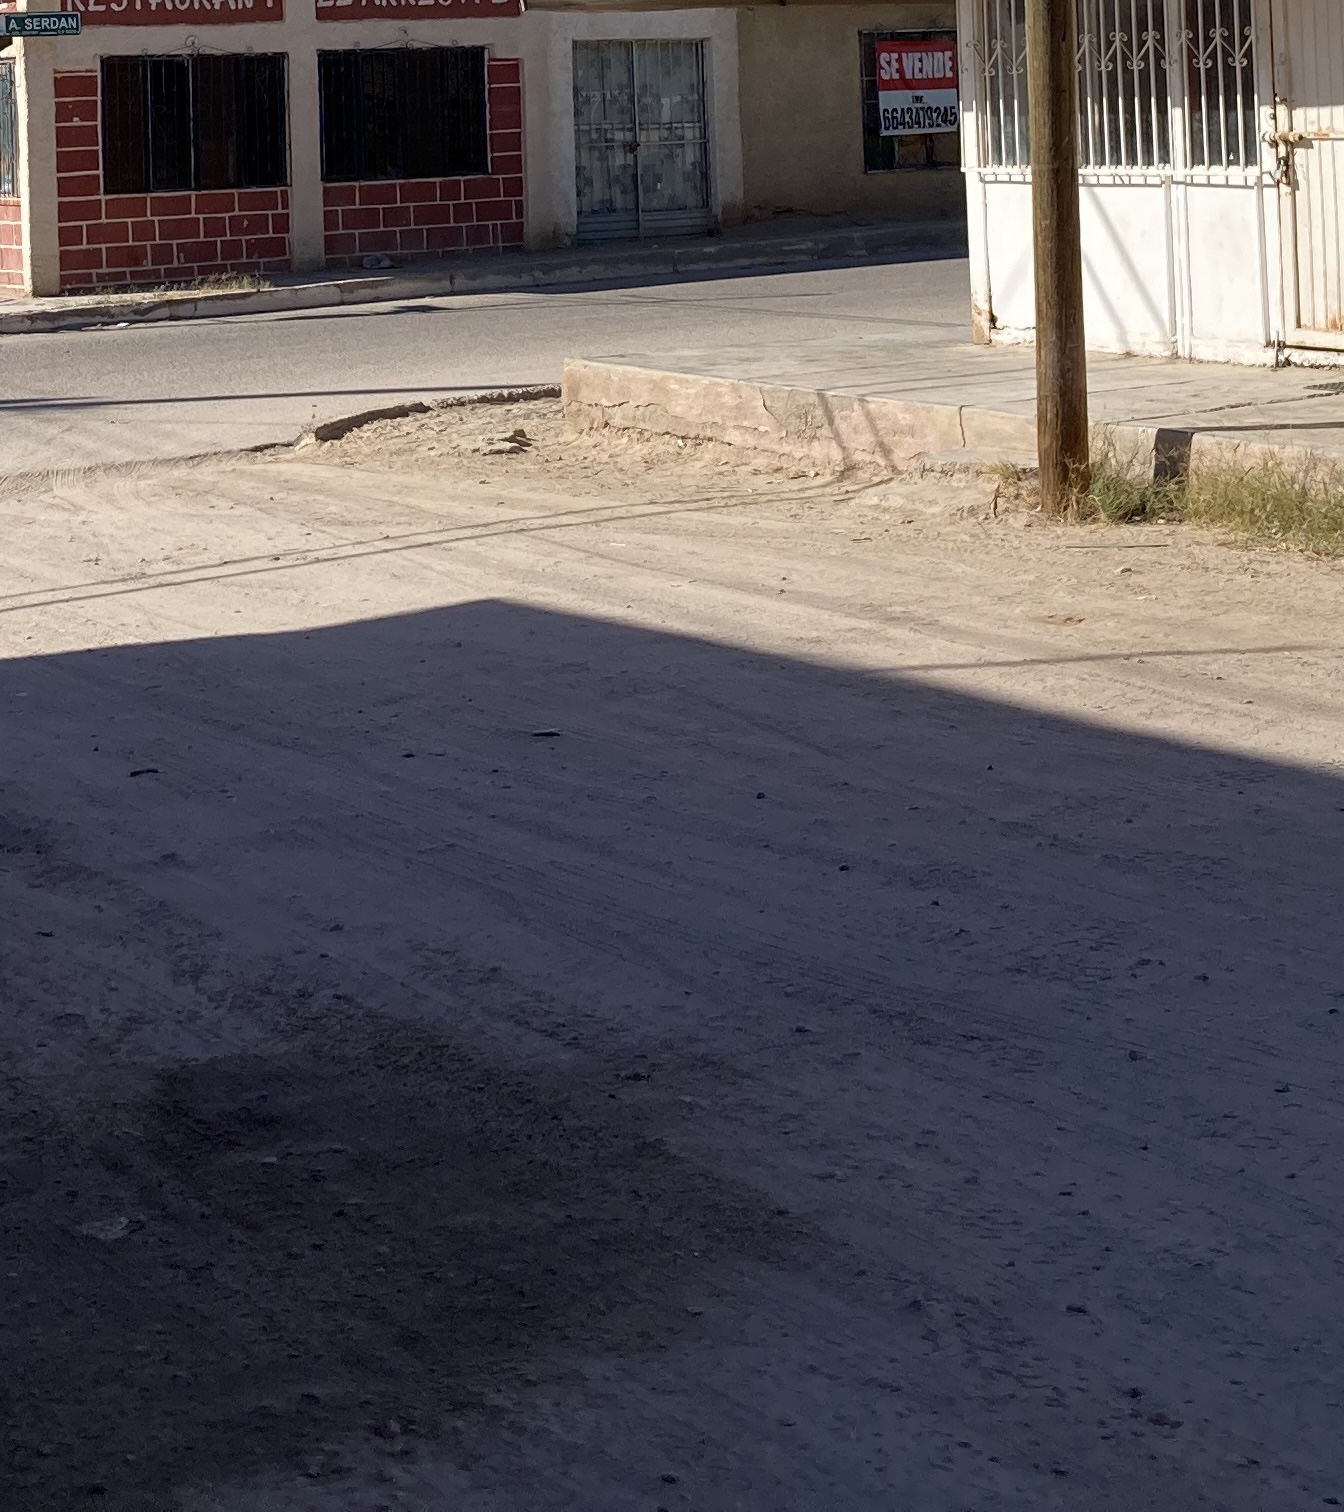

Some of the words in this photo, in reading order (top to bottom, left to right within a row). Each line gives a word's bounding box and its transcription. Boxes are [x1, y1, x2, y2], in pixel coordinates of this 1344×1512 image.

[24, 17, 77, 30] SERDAN
[879, 51, 900, 80] SE
[901, 50, 954, 80] VENDE
